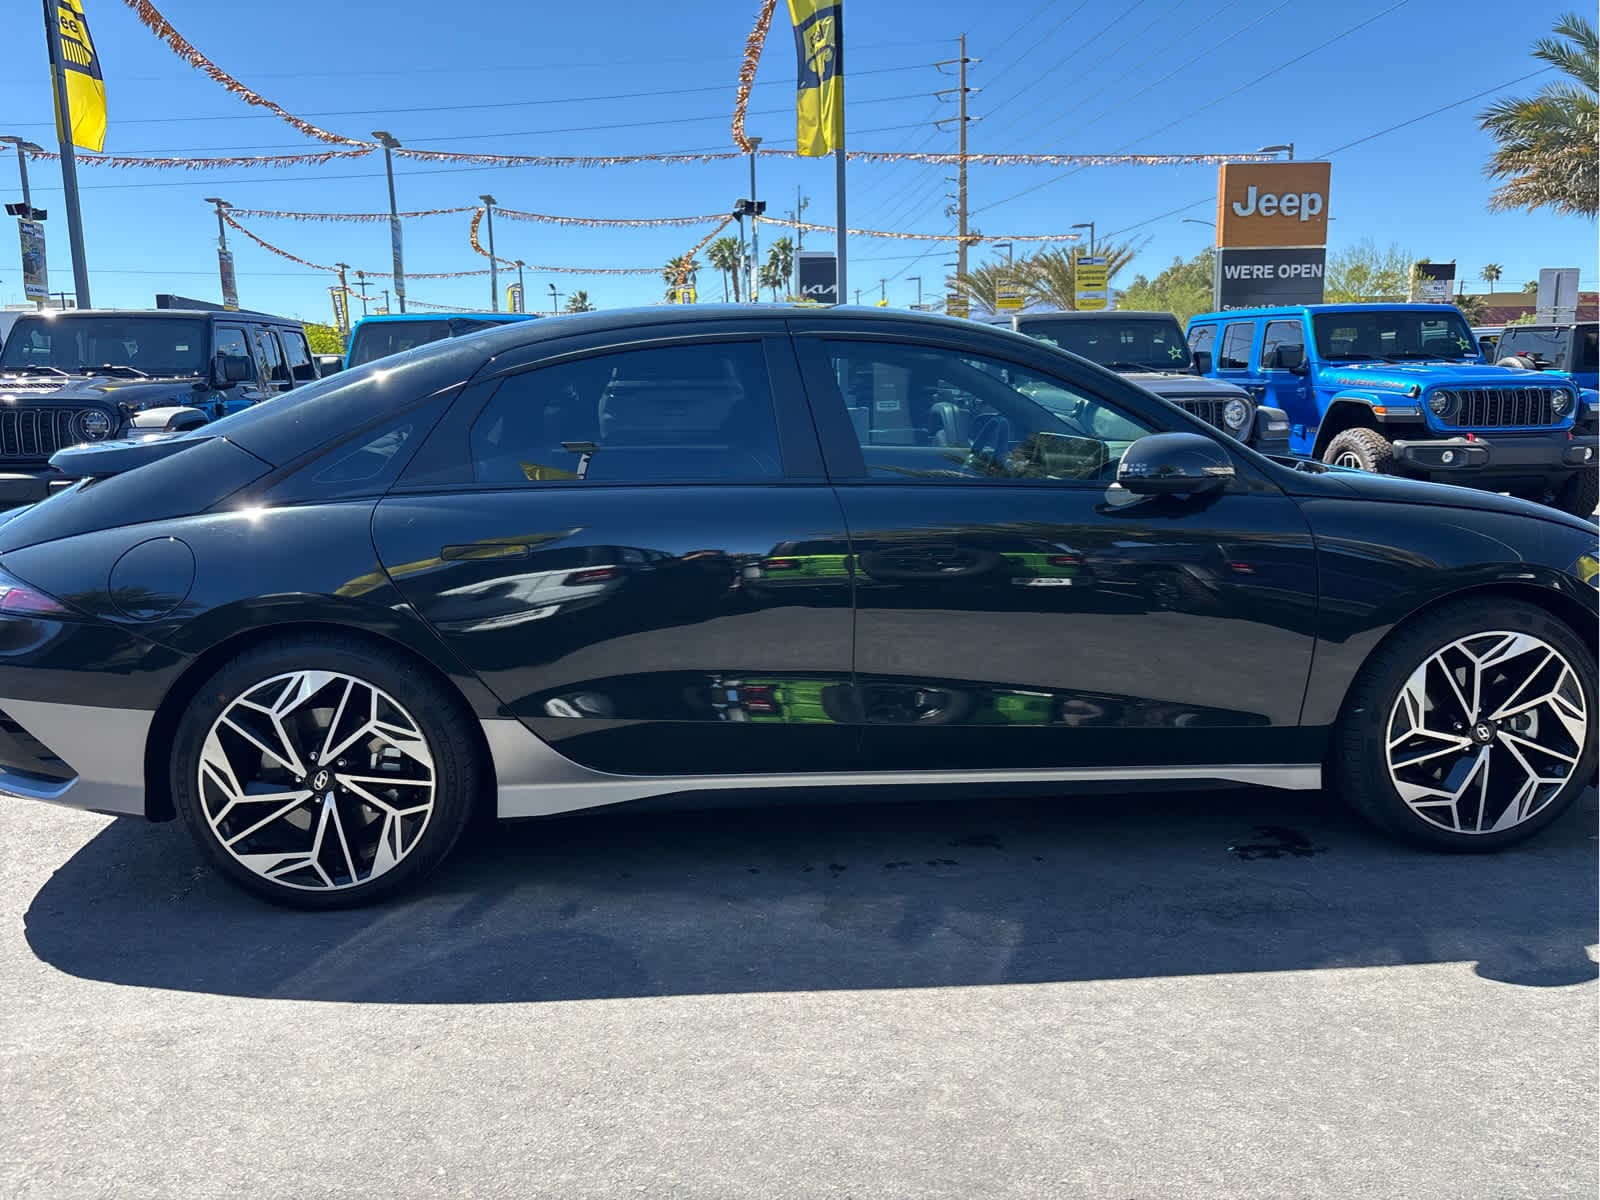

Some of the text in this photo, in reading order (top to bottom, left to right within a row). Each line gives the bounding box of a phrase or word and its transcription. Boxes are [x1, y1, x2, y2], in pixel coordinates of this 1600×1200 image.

[1232, 185, 1323, 222] Jeep
[1224, 264, 1323, 279] WE'RE OPEN
